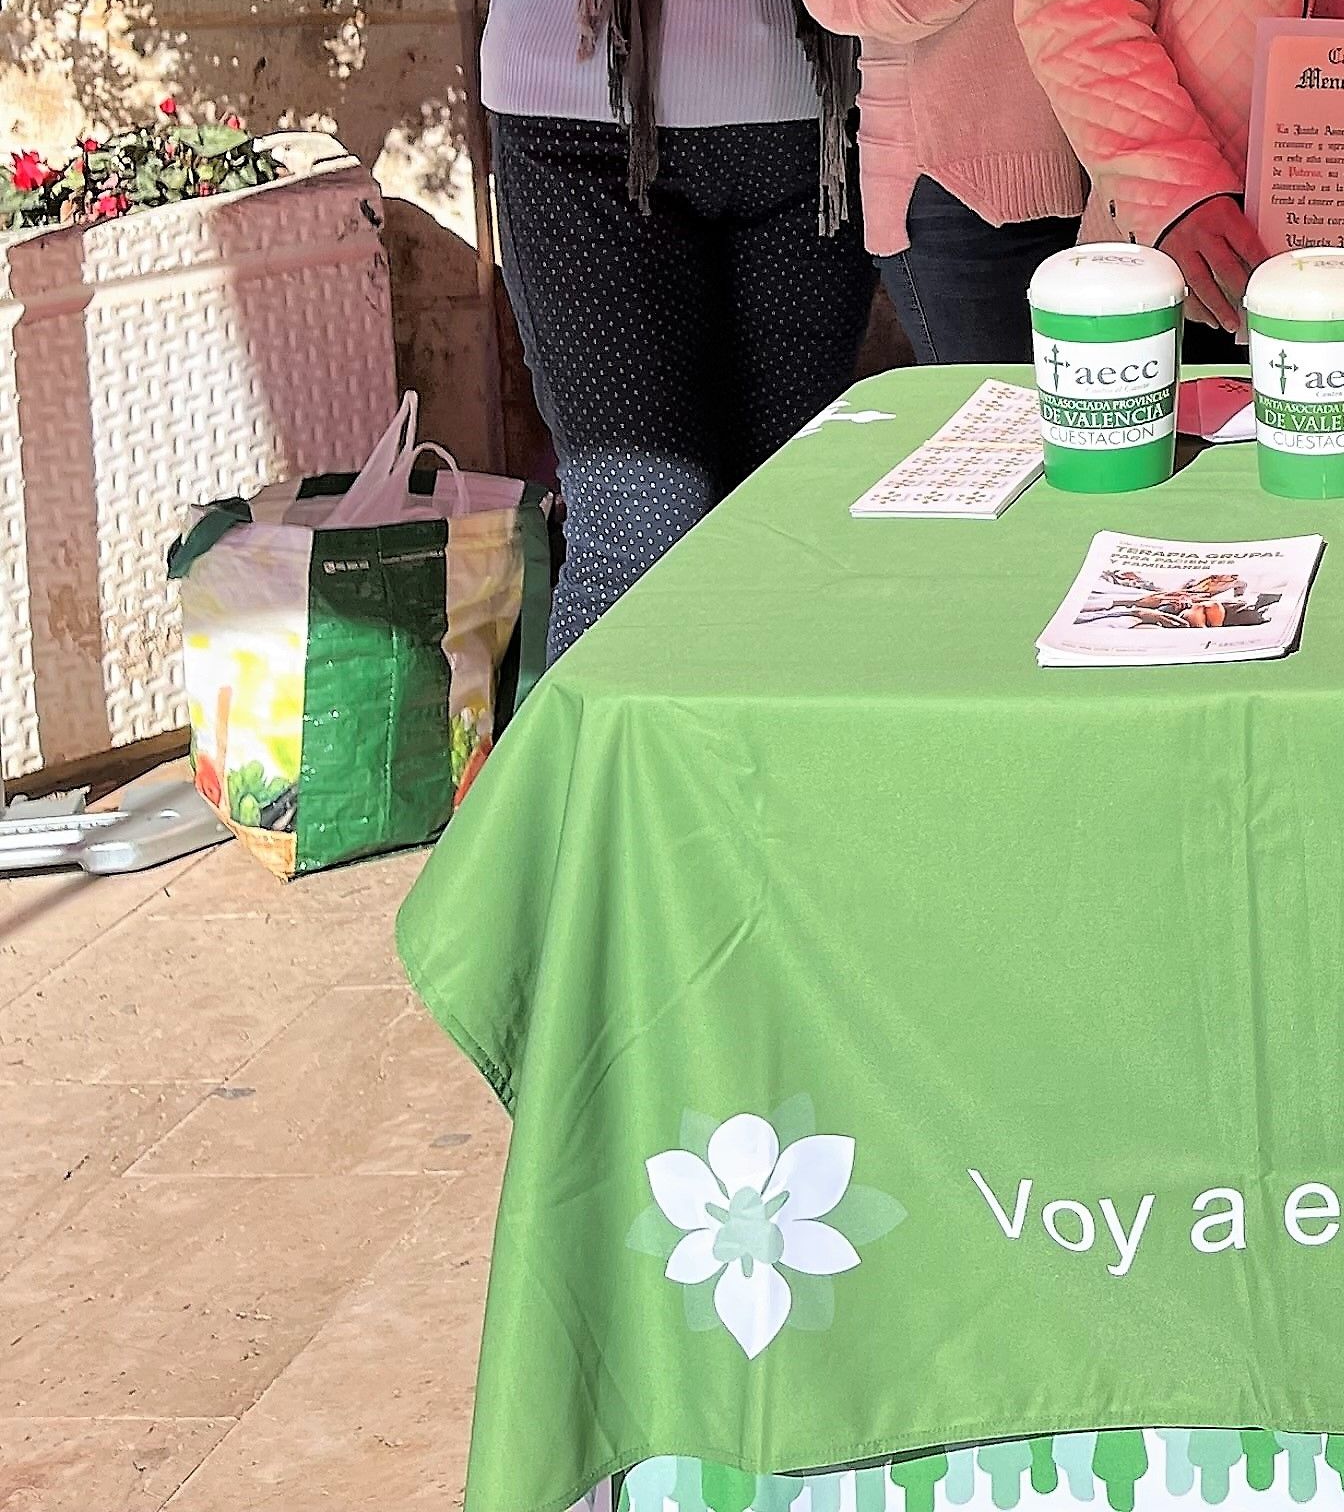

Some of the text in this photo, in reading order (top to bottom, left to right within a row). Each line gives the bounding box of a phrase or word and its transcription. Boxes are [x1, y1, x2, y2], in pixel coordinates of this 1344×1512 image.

[1337, 236, 1344, 248] 3
[1075, 360, 1159, 385] aecc
[1043, 403, 1164, 428] DE VALENCIA
[1265, 409, 1286, 427] DE
[1049, 423, 1154, 446] CUESTACION
[1116, 545, 1285, 559] TERAPIA GRUPAL
[966, 1168, 1156, 1279] Voy
[1189, 1187, 1248, 1253] a
